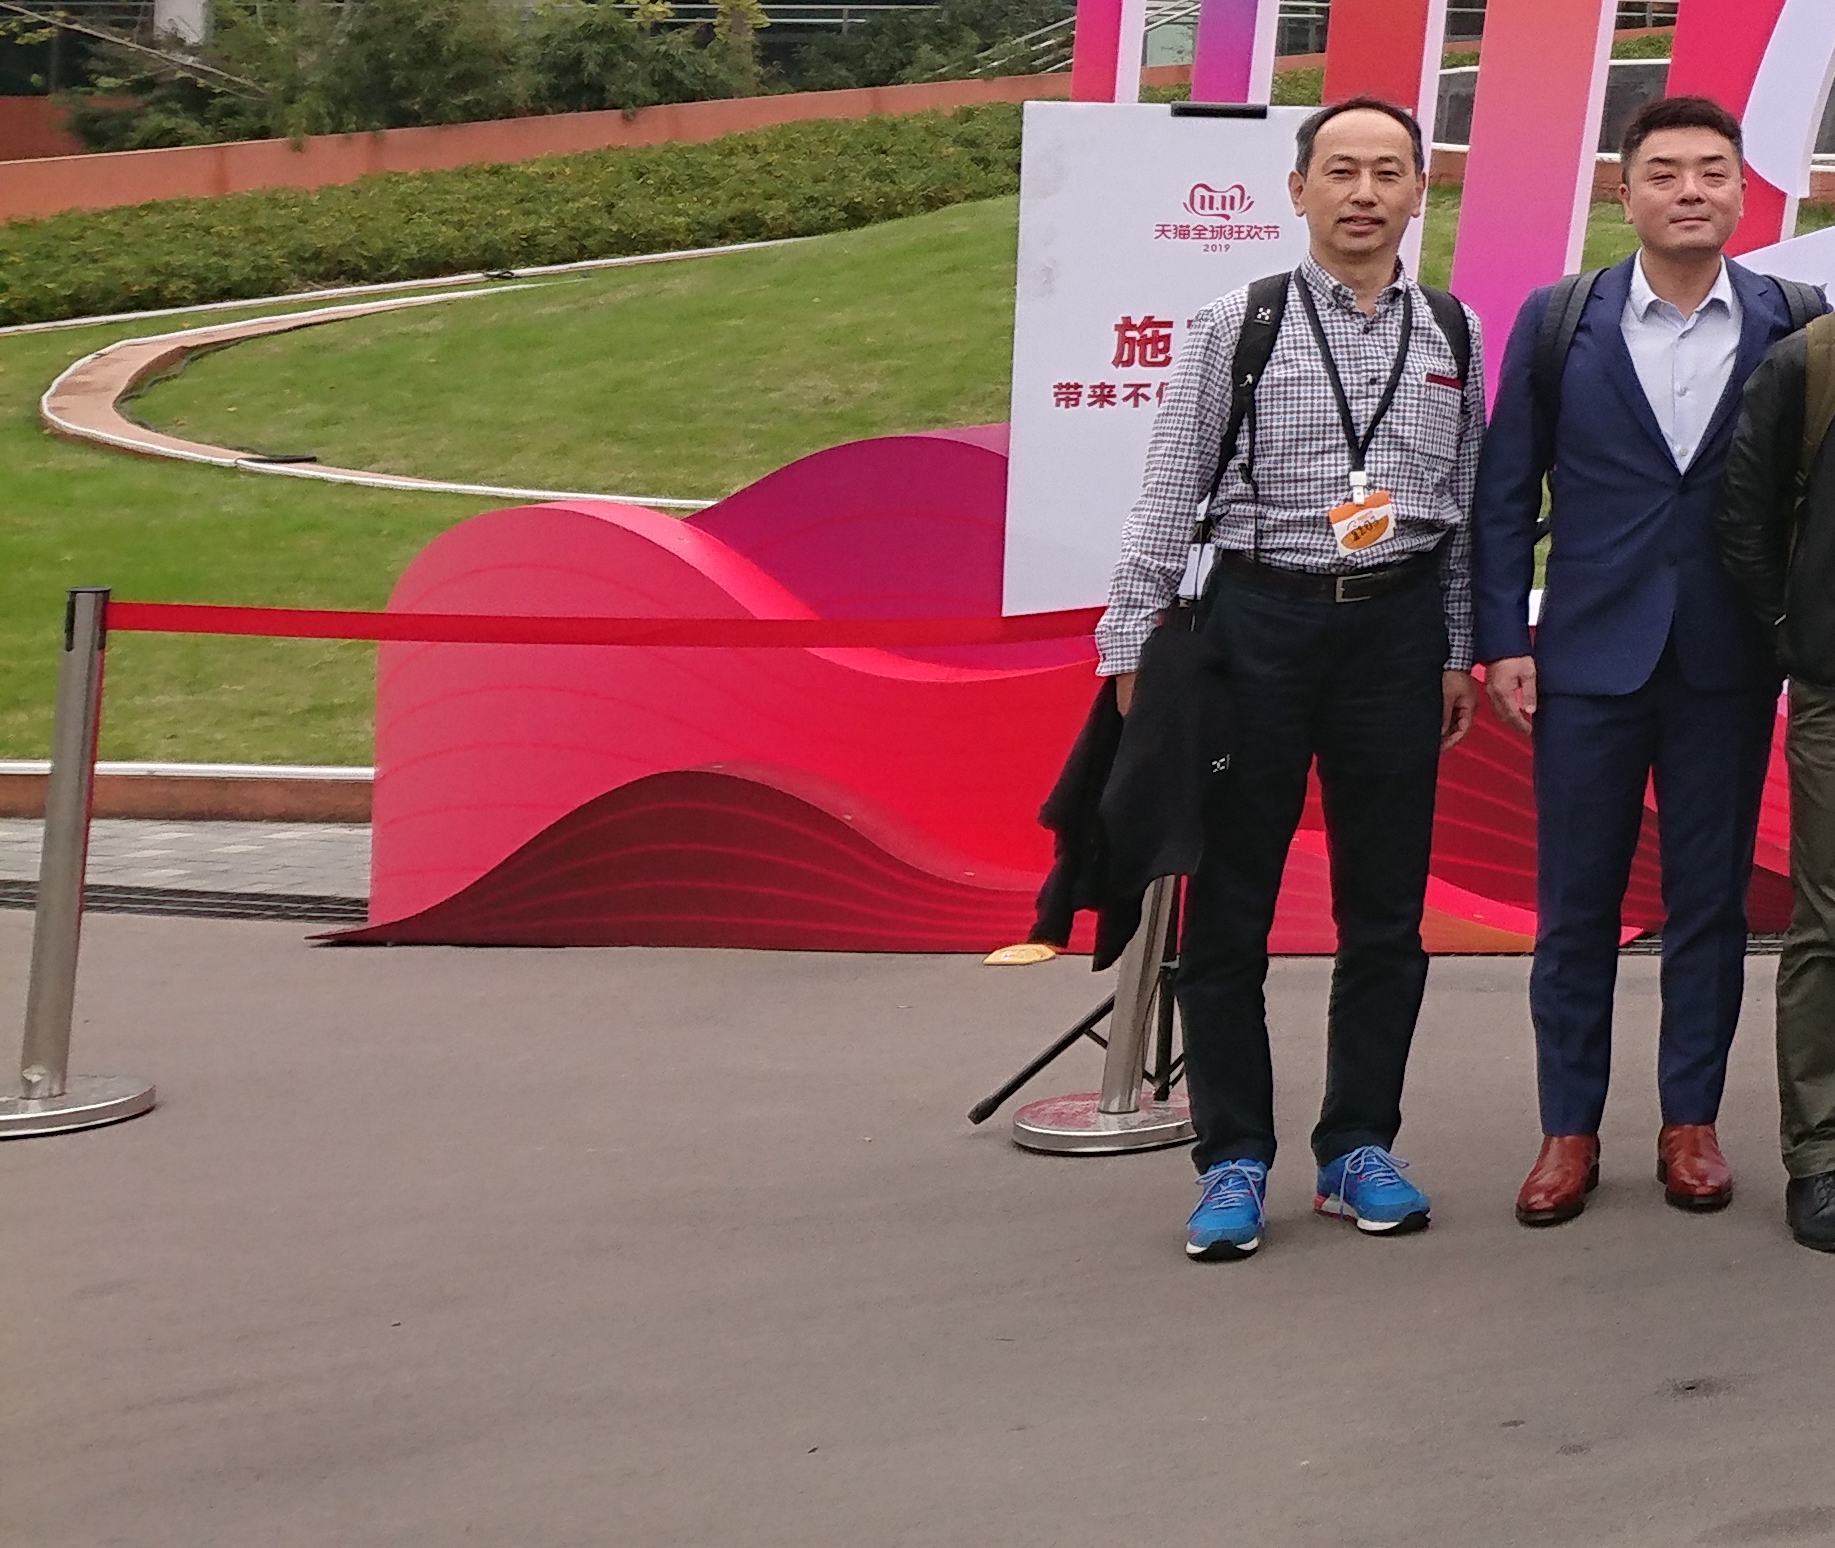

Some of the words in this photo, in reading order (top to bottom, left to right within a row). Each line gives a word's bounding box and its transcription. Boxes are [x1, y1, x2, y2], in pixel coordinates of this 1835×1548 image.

[1199, 194, 1236, 212] 11.11
[1154, 223, 1280, 241] 天猫全球狂欢节
[1202, 243, 1231, 253] 2019
[1111, 315, 1190, 369] 施
